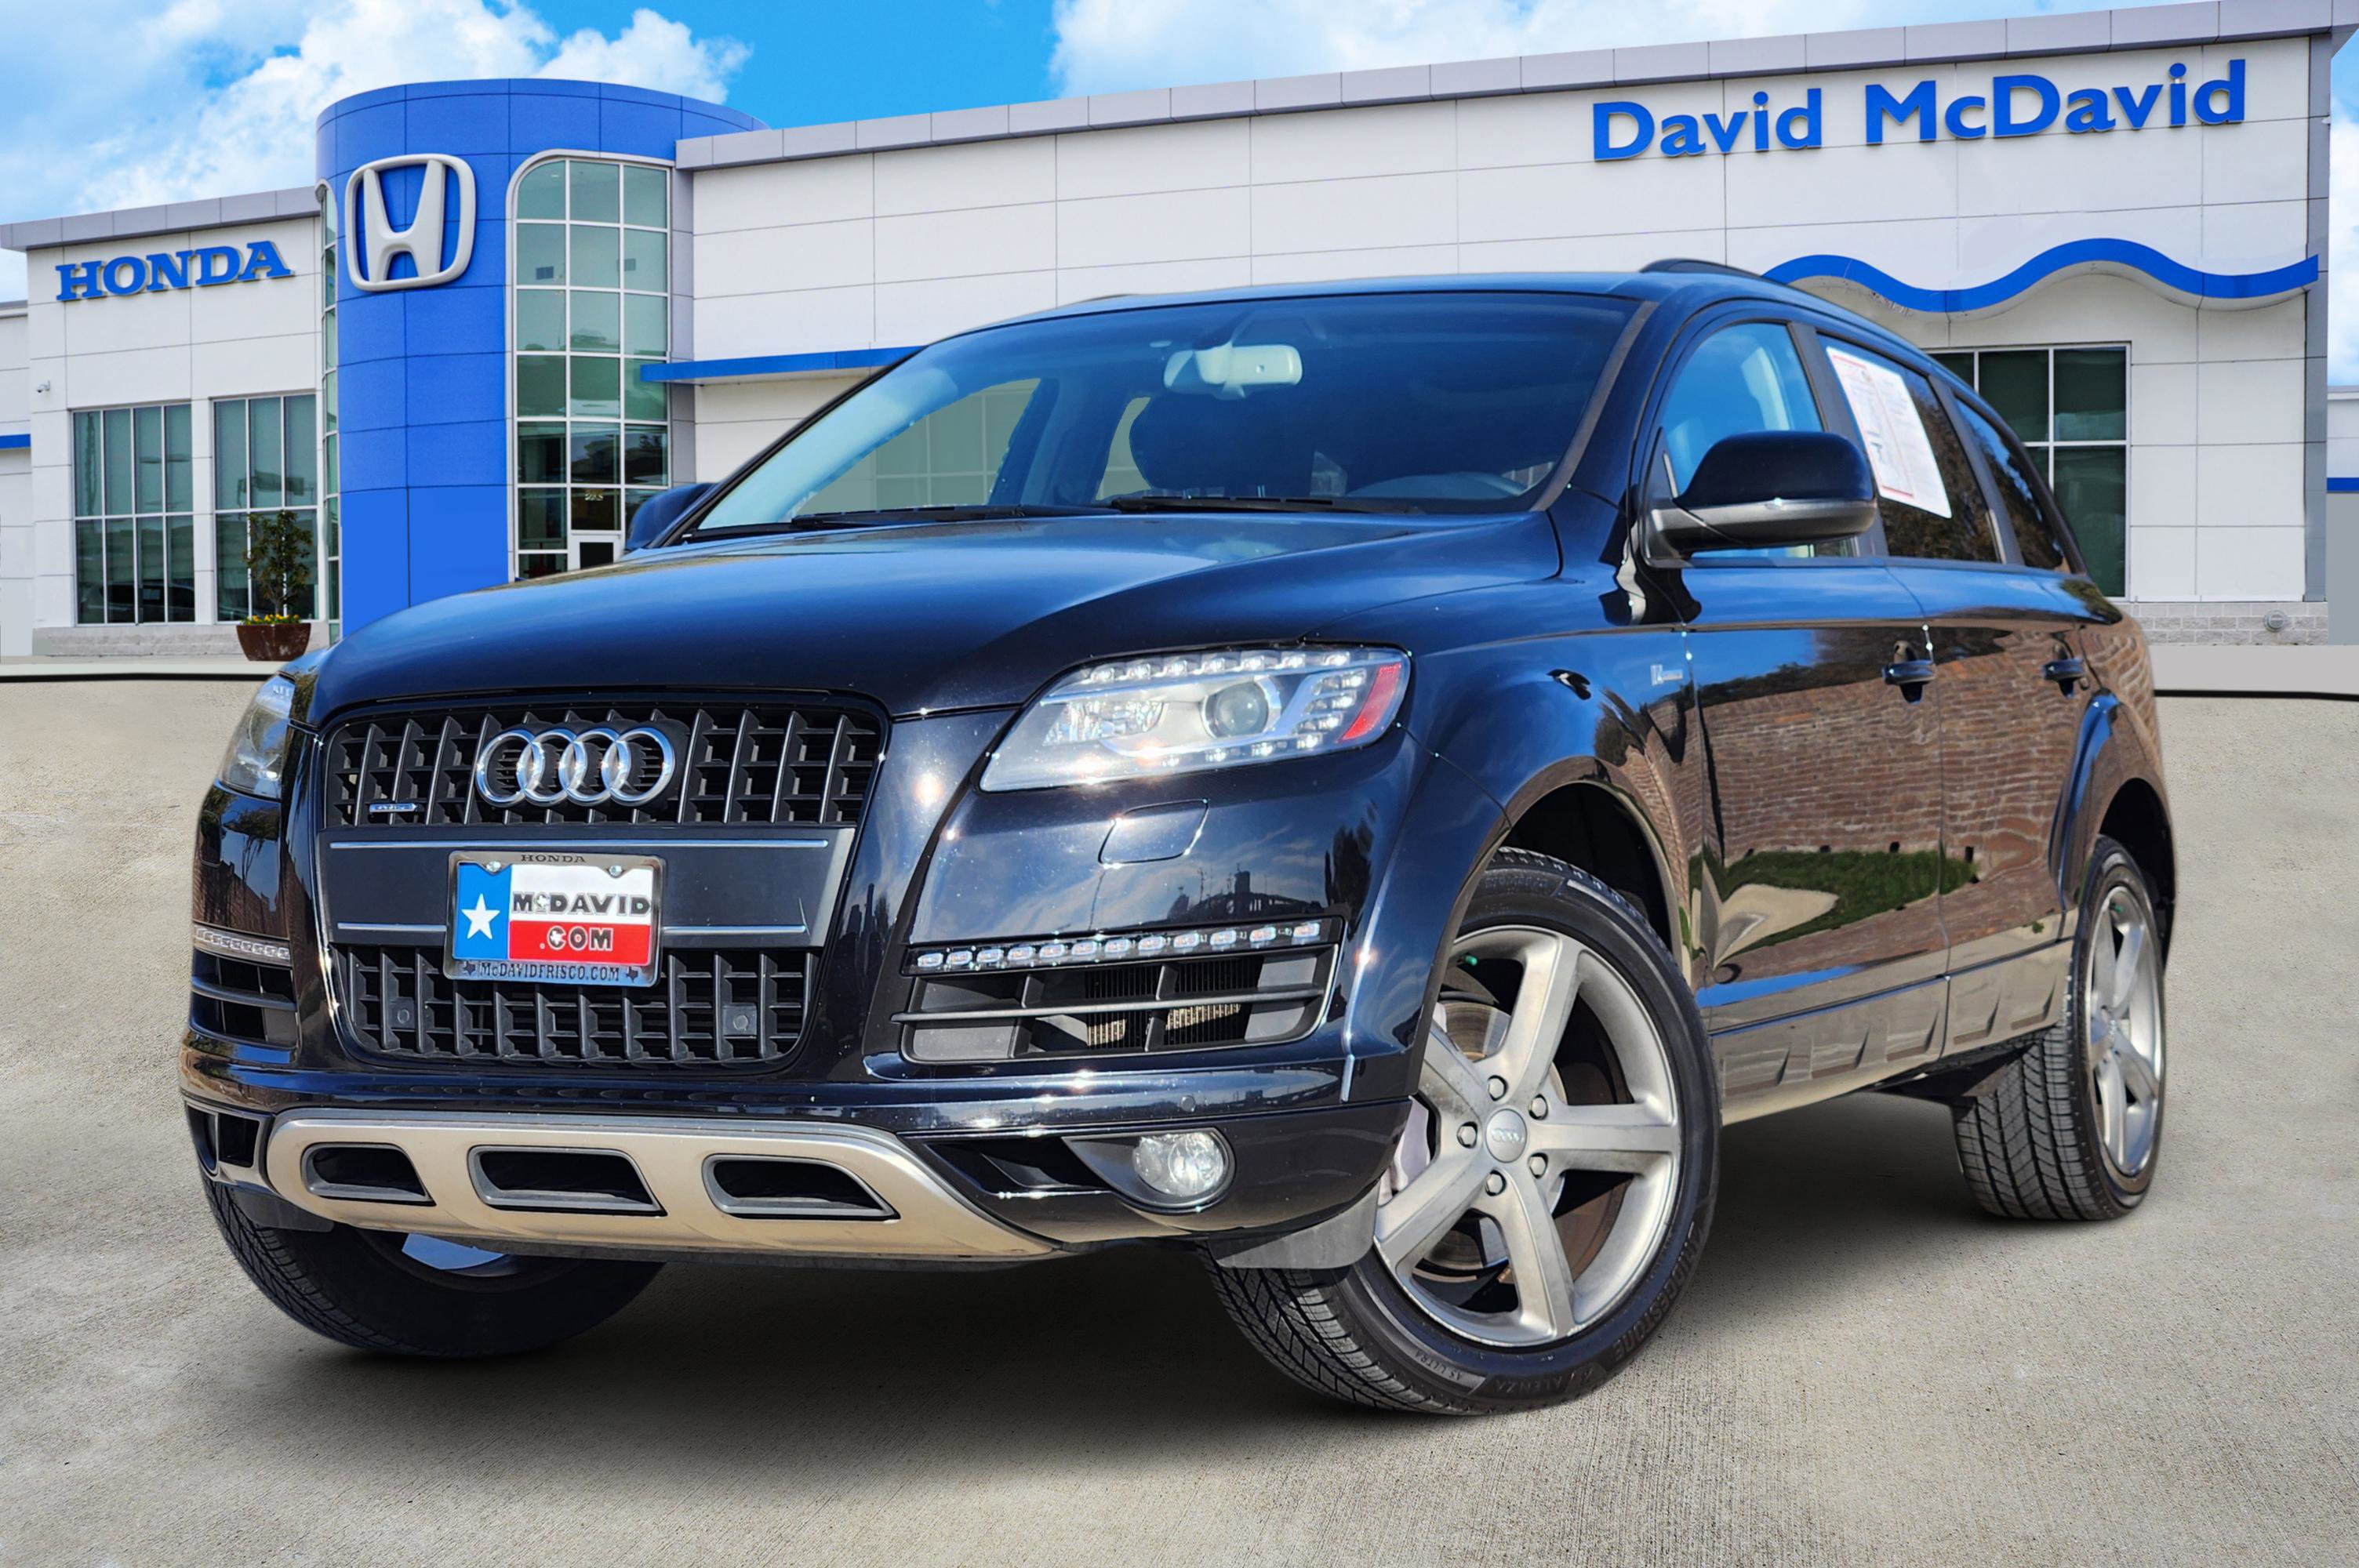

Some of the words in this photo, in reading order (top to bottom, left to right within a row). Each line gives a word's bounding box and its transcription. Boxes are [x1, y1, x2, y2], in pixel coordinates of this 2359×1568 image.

[1593, 88, 1821, 162] David
[1865, 59, 2246, 145] McDavid
[56, 240, 295, 301] HONDA
[521, 854, 586, 863] HONDA
[479, 962, 620, 981] McDAVIDFRISCO.COM
